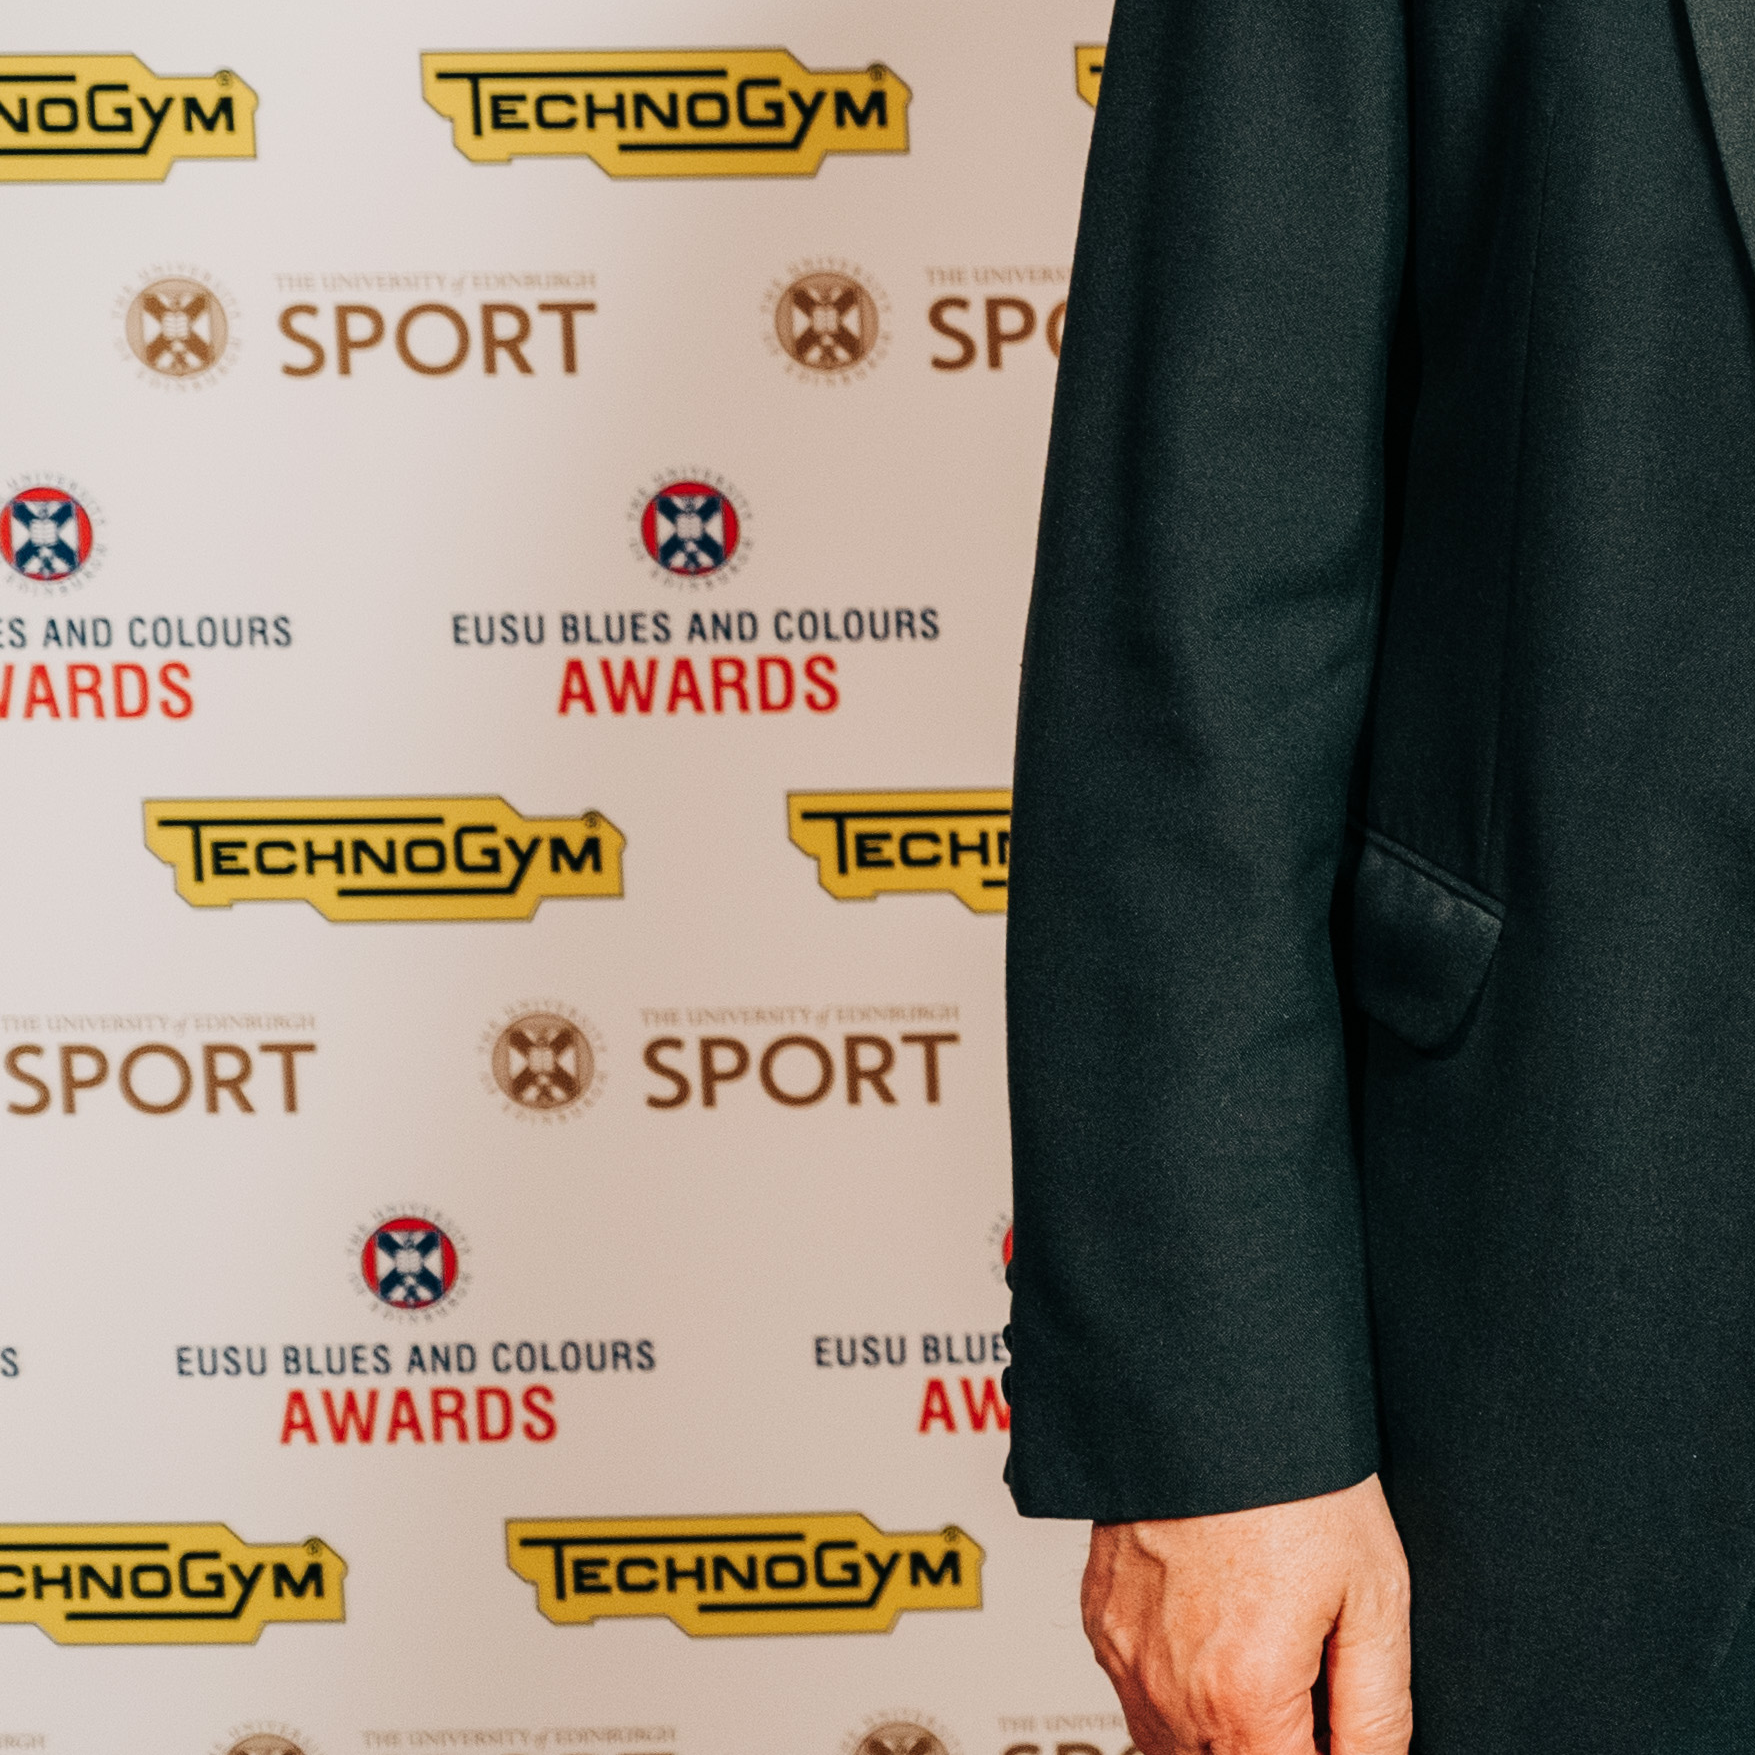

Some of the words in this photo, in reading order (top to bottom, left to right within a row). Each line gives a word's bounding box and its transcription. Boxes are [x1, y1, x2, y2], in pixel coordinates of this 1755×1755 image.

[321, 271, 446, 292] UNIVERSITY
[278, 300, 598, 378] SPORT
[452, 612, 546, 646] EUSU
[560, 610, 673, 645] BLUES
[686, 610, 759, 643] AND
[772, 607, 941, 643] COLOURS
[558, 653, 840, 715] AWARDS
[46, 1014, 171, 1033] UNIVERSITY
[686, 1006, 812, 1026] UNIVERSITY
[4, 1041, 318, 1117] SPORT
[642, 1031, 961, 1111] SPORT
[176, 1345, 268, 1377] EUSU
[282, 1343, 393, 1376] BLUES
[406, 1341, 478, 1375] AND
[491, 1338, 657, 1375] COLOURS
[280, 1384, 558, 1445] AWARDS
